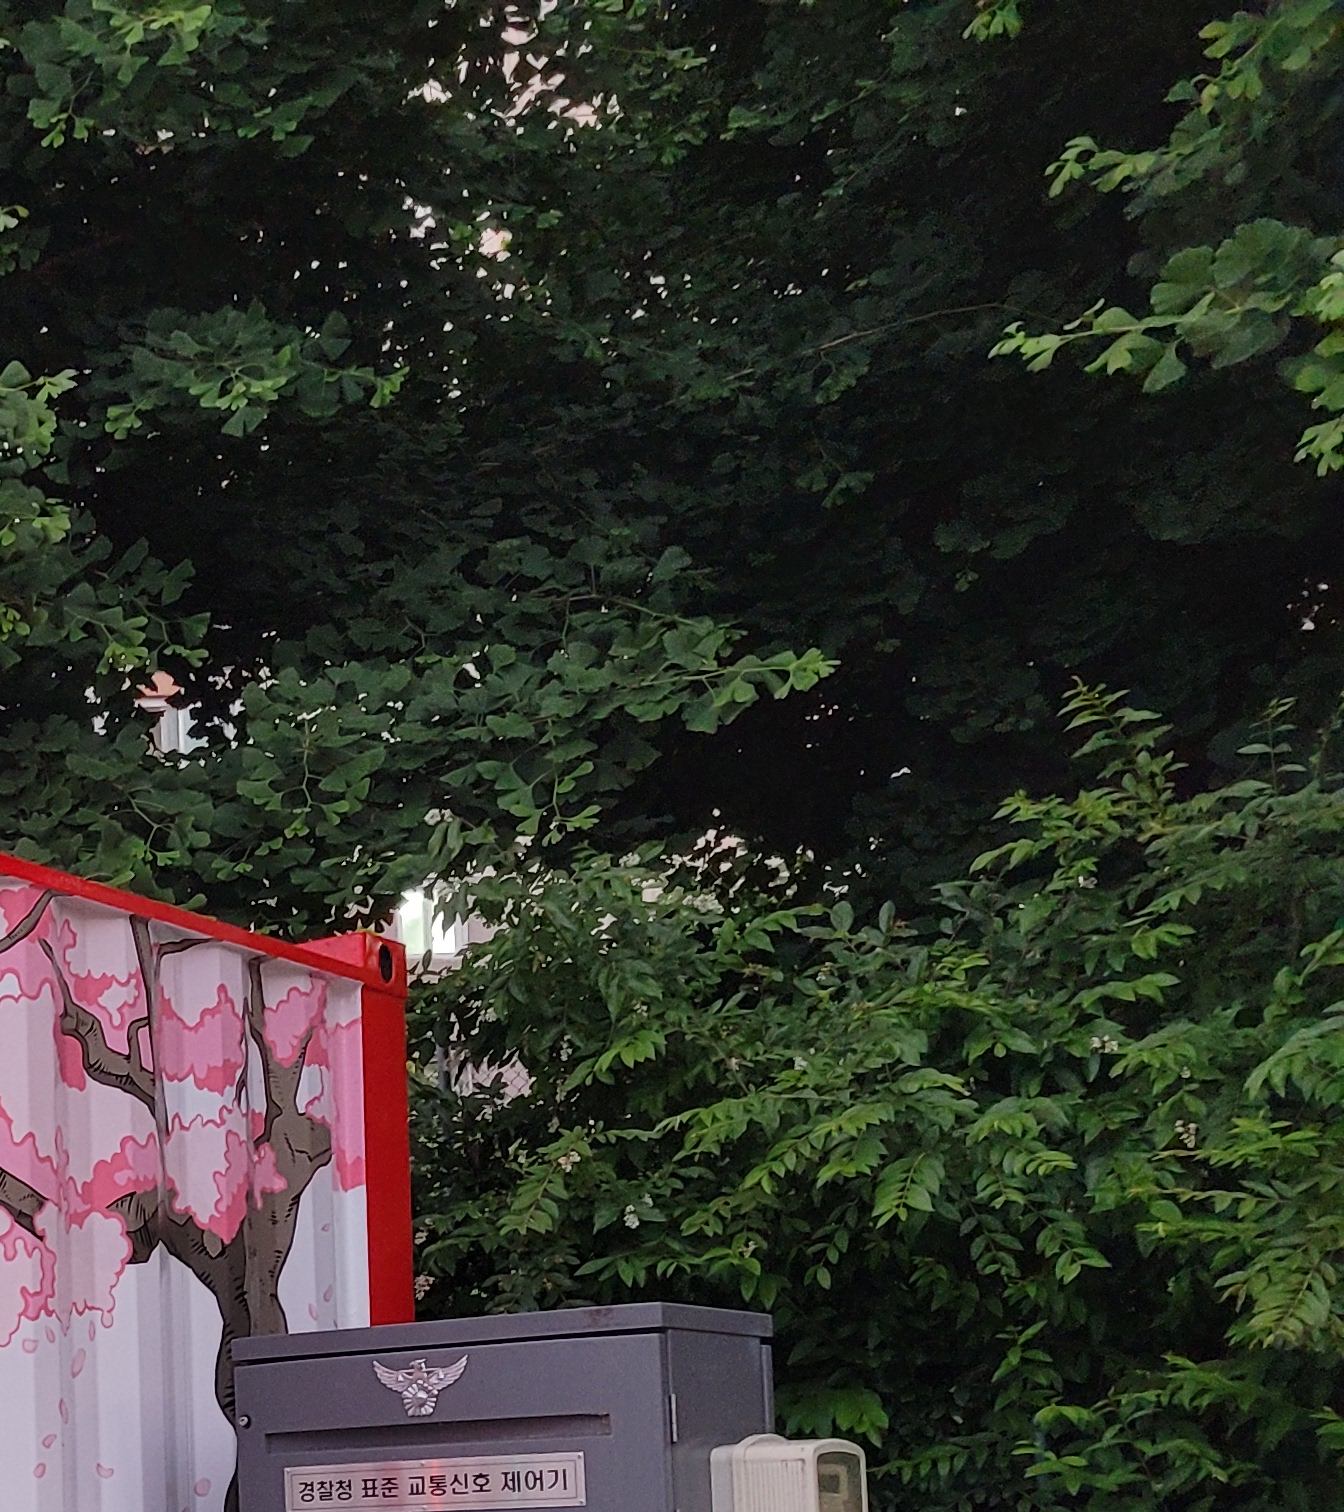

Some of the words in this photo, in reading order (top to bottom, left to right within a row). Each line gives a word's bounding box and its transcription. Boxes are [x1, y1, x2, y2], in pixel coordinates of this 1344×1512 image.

[298, 1478, 353, 1503] 경찰청
[361, 1476, 400, 1499] 표준
[408, 1472, 492, 1498] 교통신호
[500, 1468, 568, 1494] 제어기
